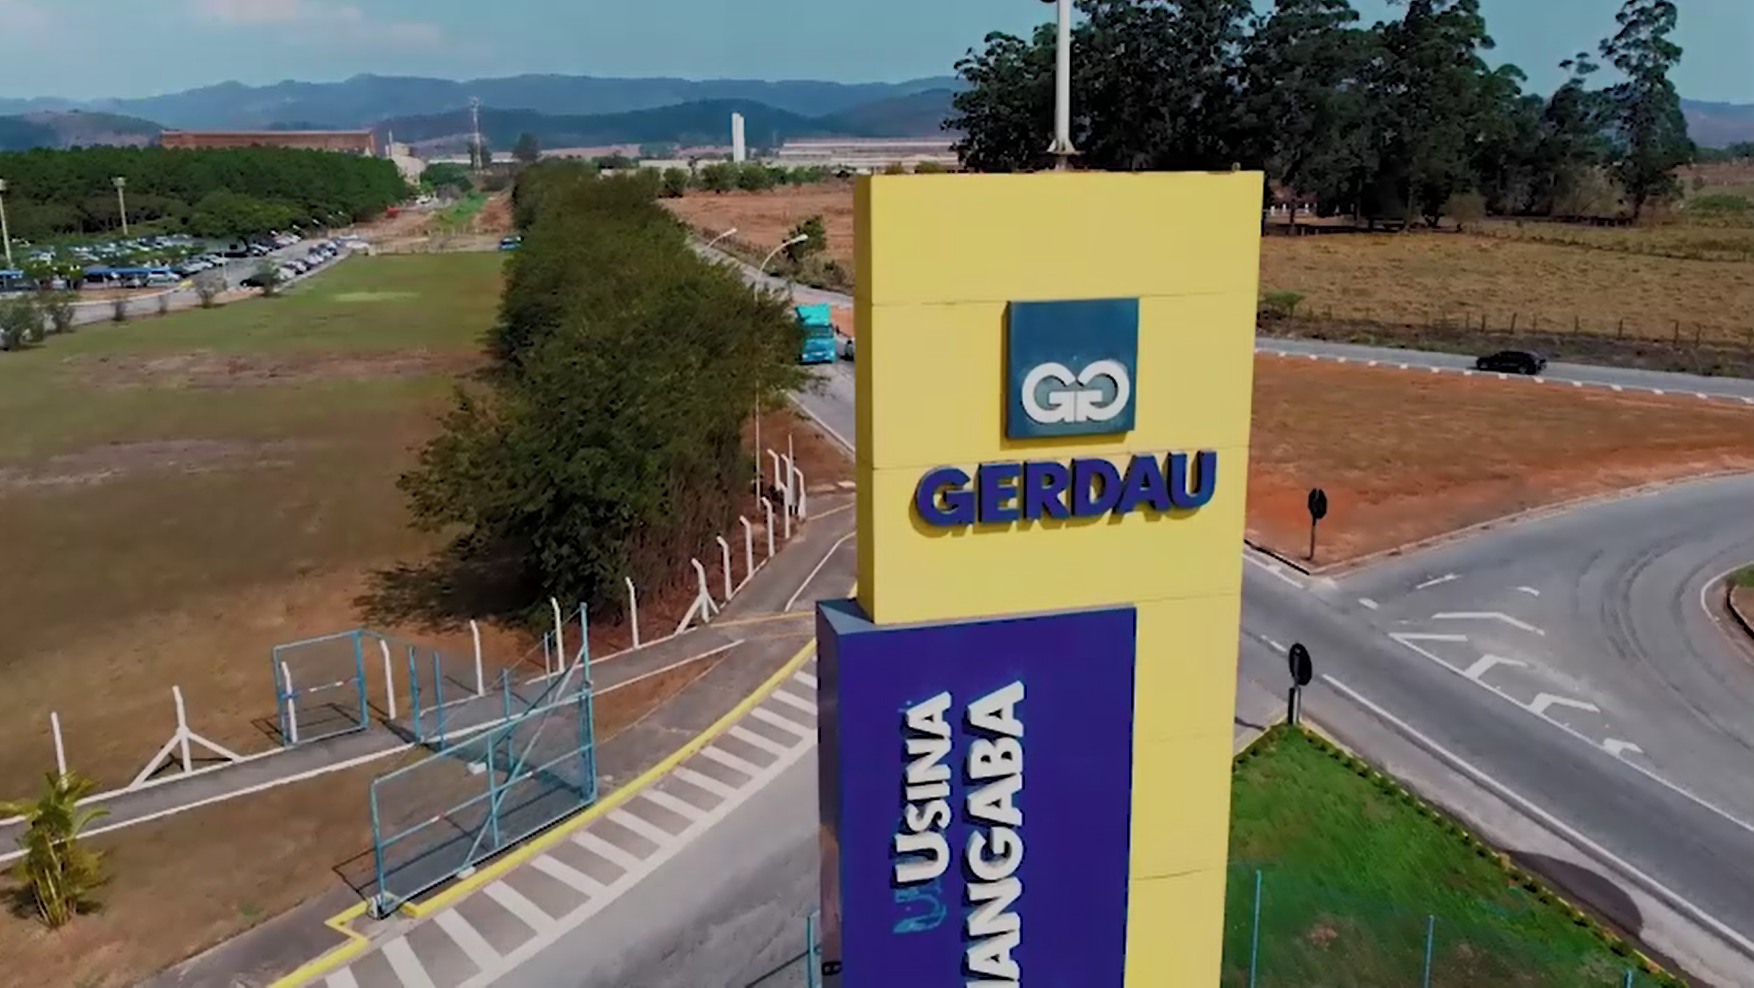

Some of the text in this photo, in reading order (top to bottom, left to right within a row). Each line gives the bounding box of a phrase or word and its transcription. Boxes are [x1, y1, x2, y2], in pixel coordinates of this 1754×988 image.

[915, 450, 1218, 527] GERDAU
[894, 690, 952, 883] USINA
[965, 680, 1024, 988] ANGABA
